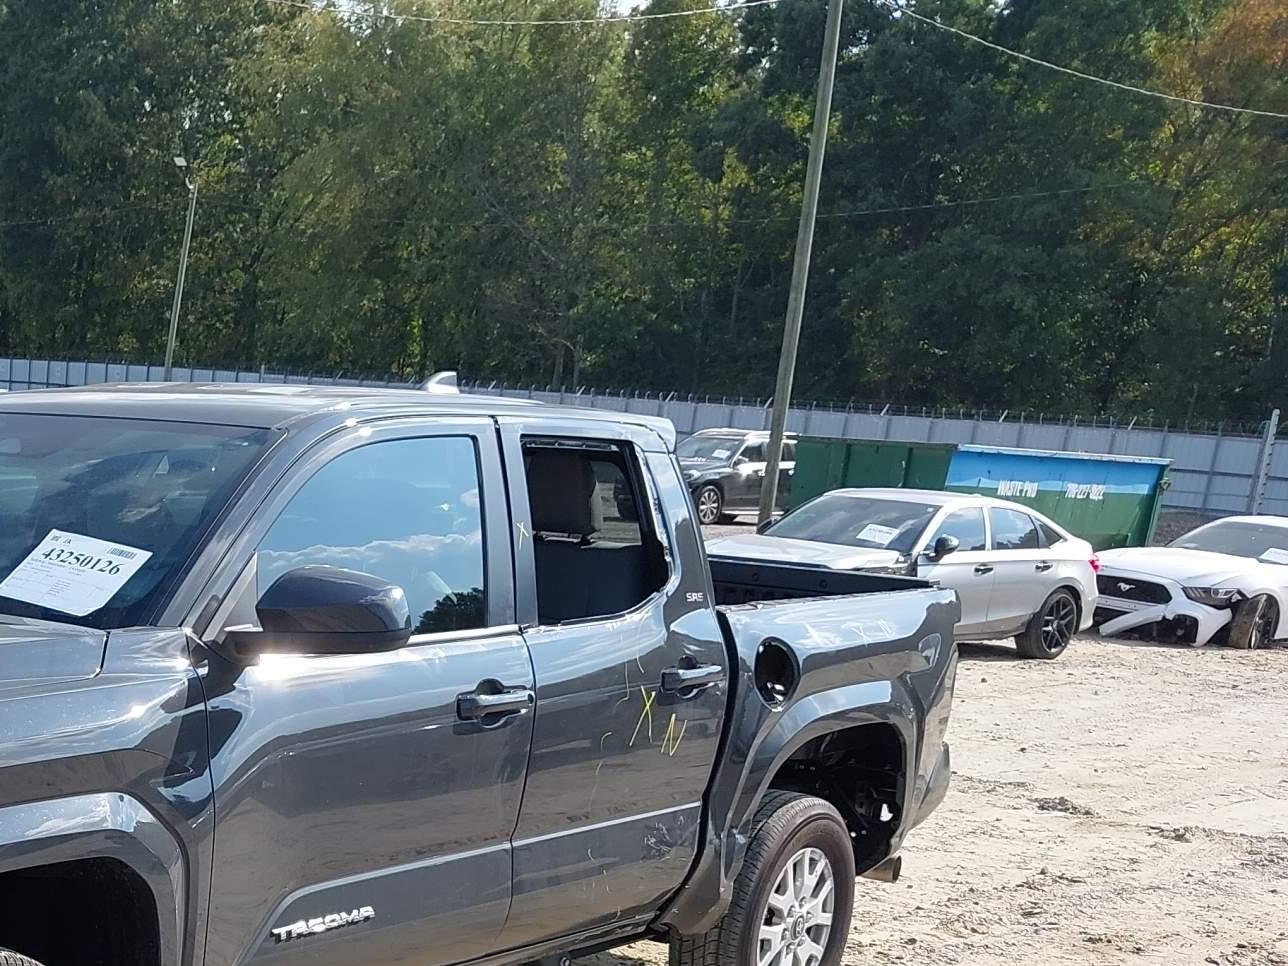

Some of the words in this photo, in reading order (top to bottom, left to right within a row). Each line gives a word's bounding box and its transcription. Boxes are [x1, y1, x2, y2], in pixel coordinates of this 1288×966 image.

[997, 480, 1024, 497] WASTE
[1022, 481, 1038, 498] PRO
[41, 548, 123, 576] 43250126
[271, 905, 376, 942] TACOMA
